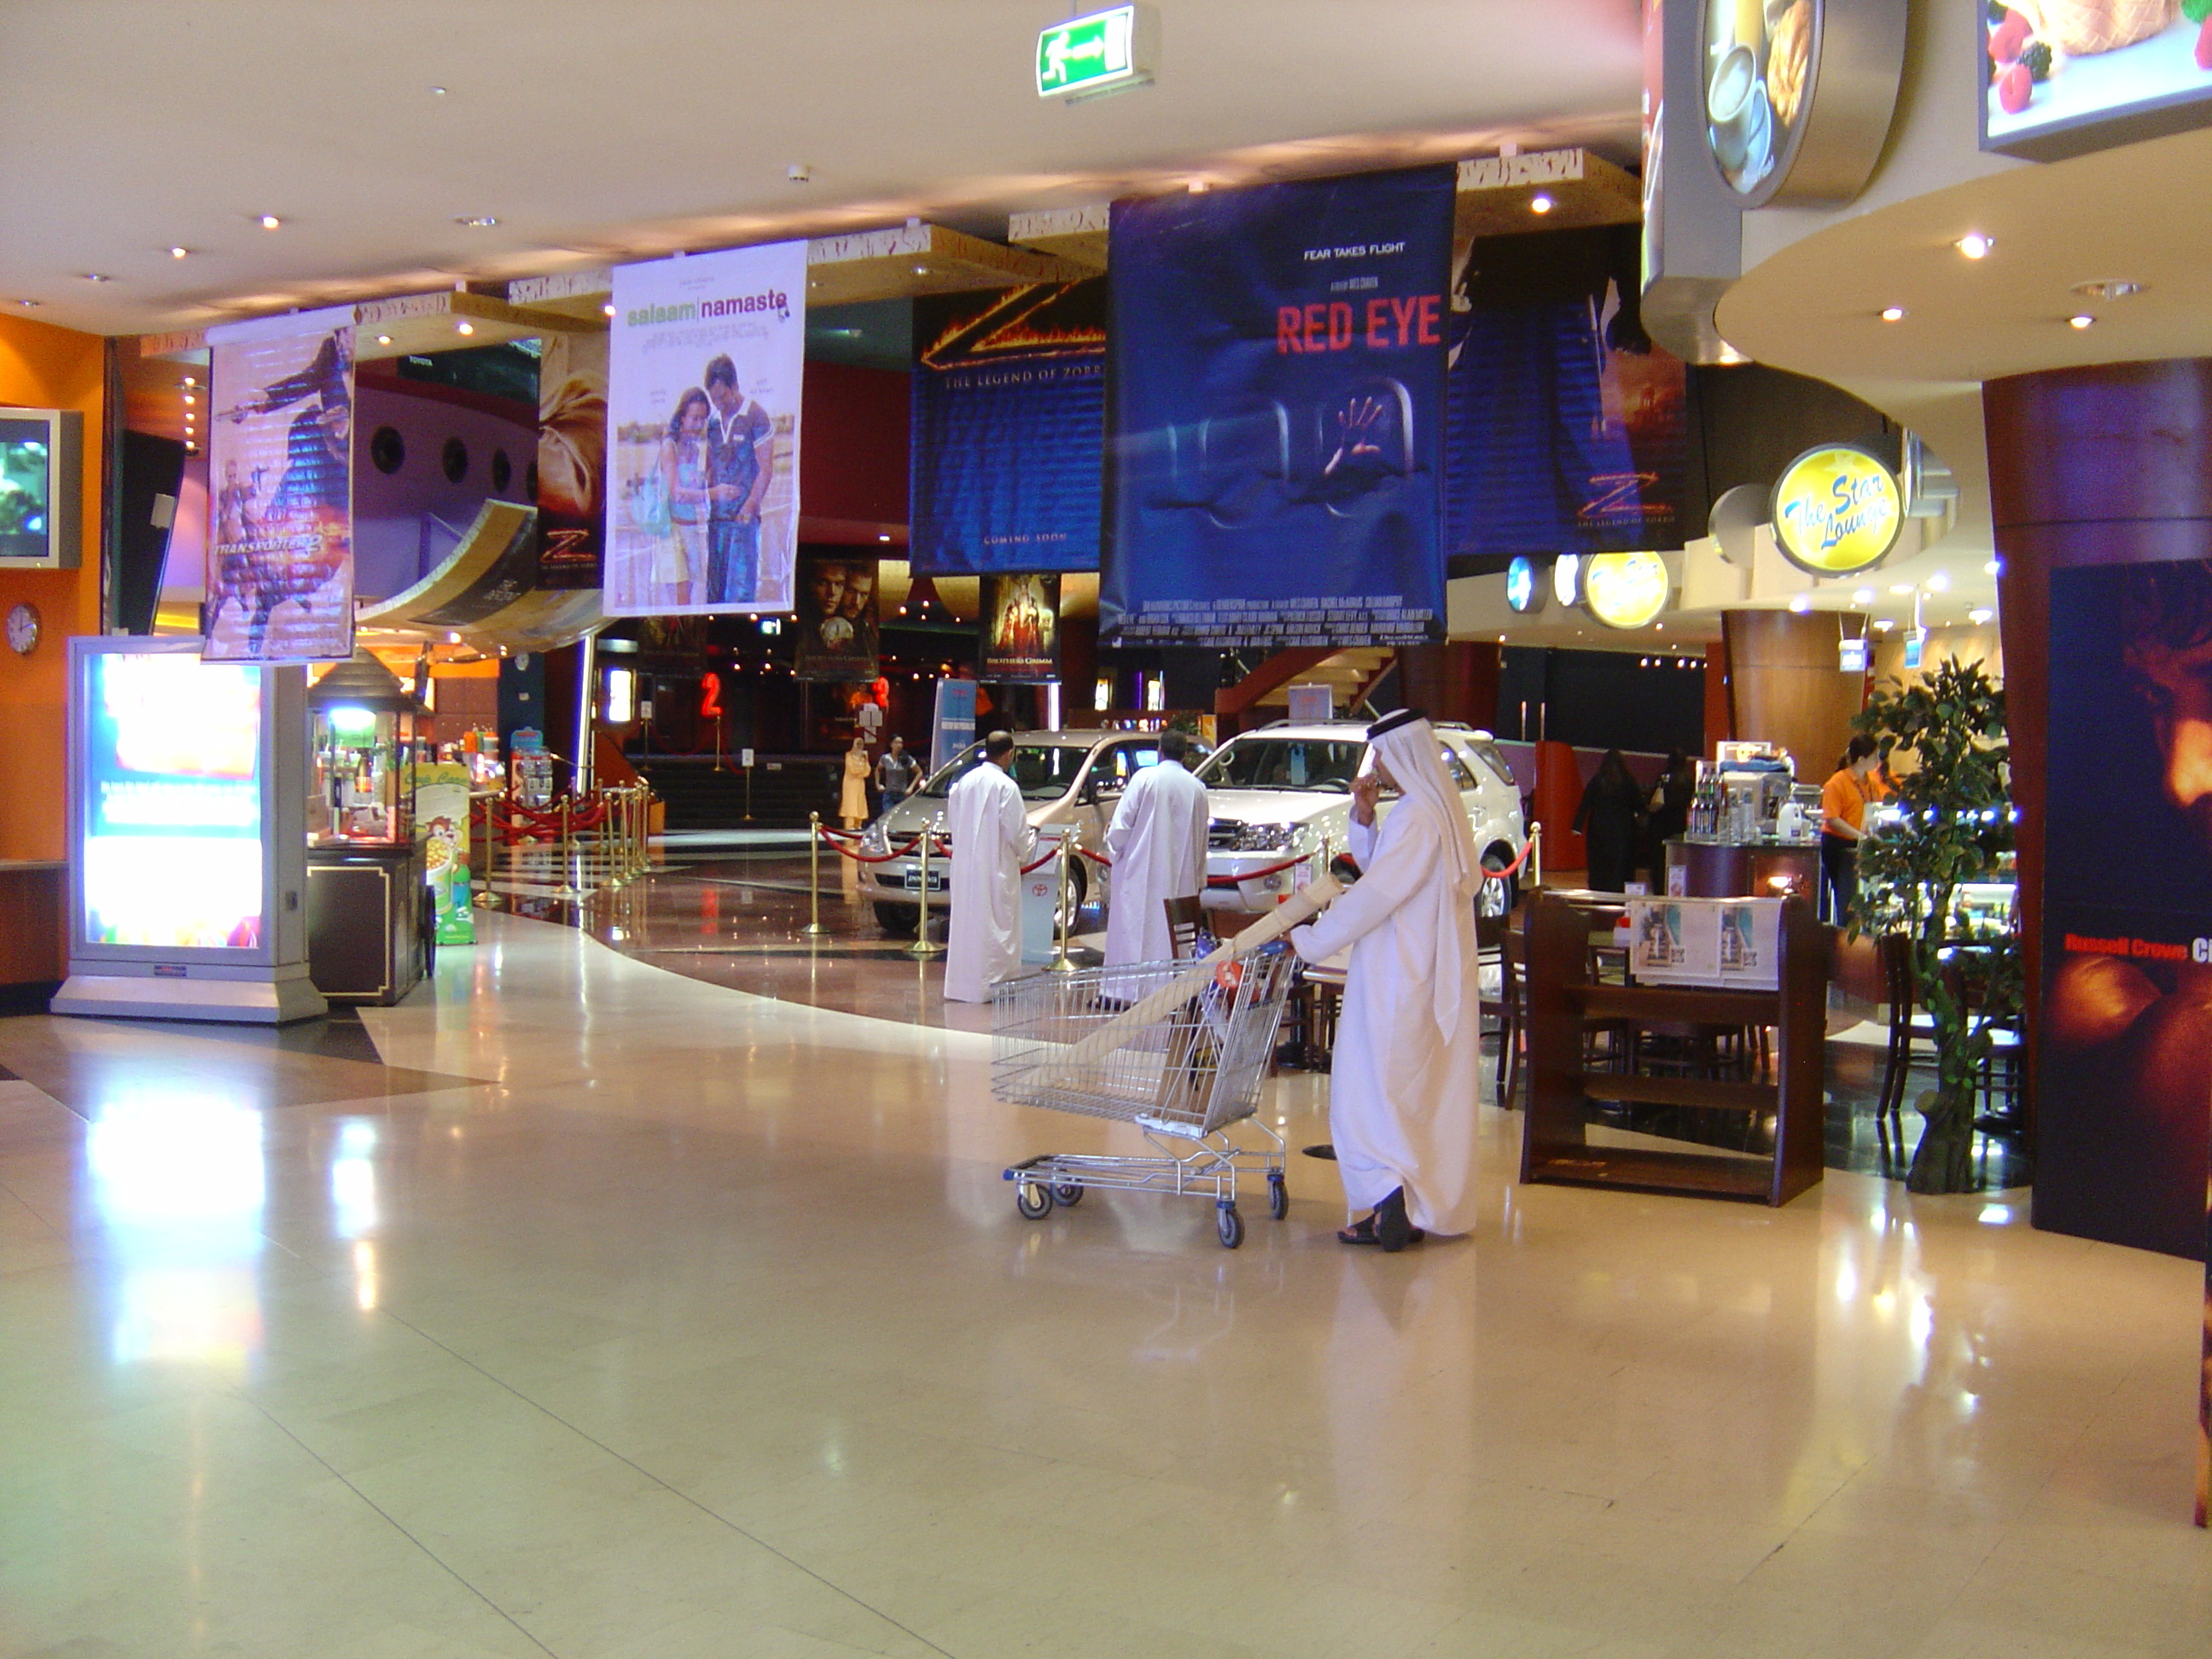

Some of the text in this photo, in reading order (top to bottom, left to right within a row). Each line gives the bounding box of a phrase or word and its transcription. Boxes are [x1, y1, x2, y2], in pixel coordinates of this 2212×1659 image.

[1303, 242, 1406, 261] FEAR TAKES FLIGHT
[626, 288, 787, 327] salaam namaste
[1277, 294, 1441, 354] RED EYE
[945, 364, 1103, 389] THE LEGEND OF ZORR
[1785, 474, 1883, 535] The Star
[983, 531, 1068, 545] COMING SOON
[1820, 499, 1888, 550] Lounge
[701, 672, 722, 716] 2
[2131, 938, 2188, 960] Crowe
